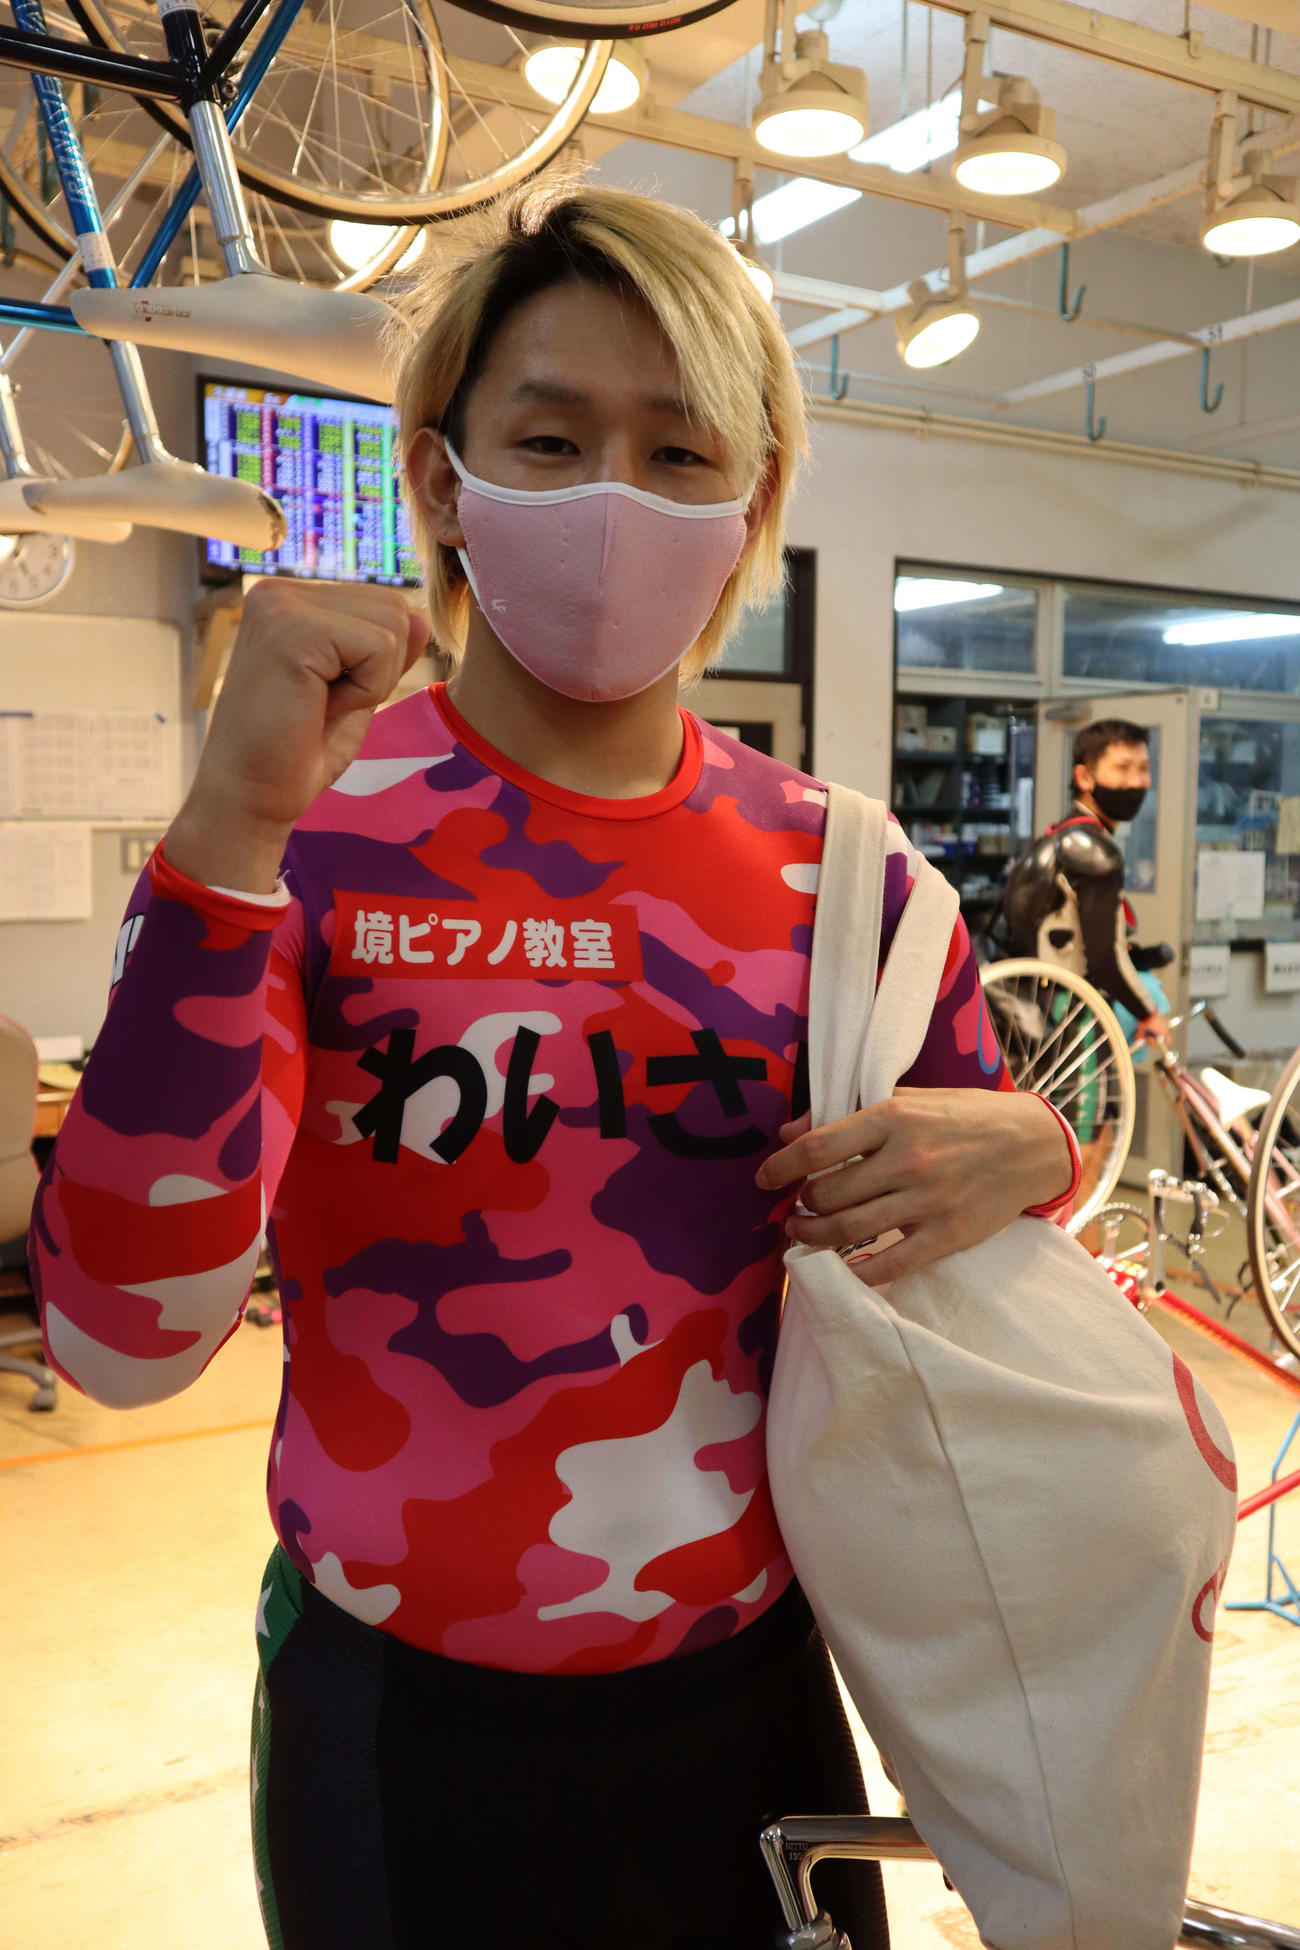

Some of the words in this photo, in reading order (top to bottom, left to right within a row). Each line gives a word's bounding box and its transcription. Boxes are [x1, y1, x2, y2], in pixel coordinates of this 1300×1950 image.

[351, 909, 616, 970] 境ピアノ教室
[352, 1025, 811, 1164] わいさ
